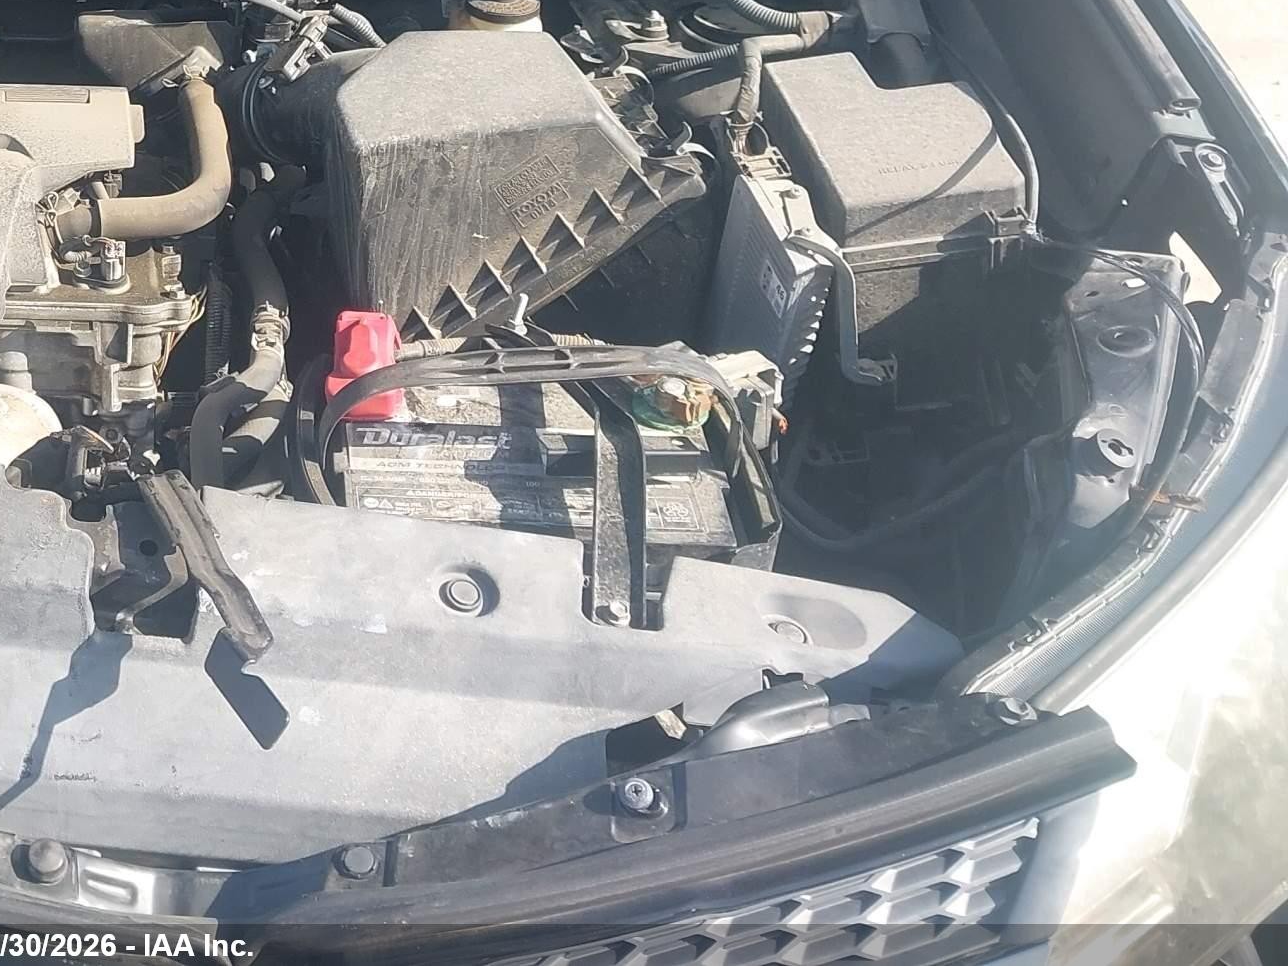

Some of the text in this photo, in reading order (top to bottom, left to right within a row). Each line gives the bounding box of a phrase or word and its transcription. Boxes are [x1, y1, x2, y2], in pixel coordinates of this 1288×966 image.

[513, 182, 562, 218] TOYOTA
[355, 427, 513, 450] Duralast
[376, 460, 412, 469] AGM
